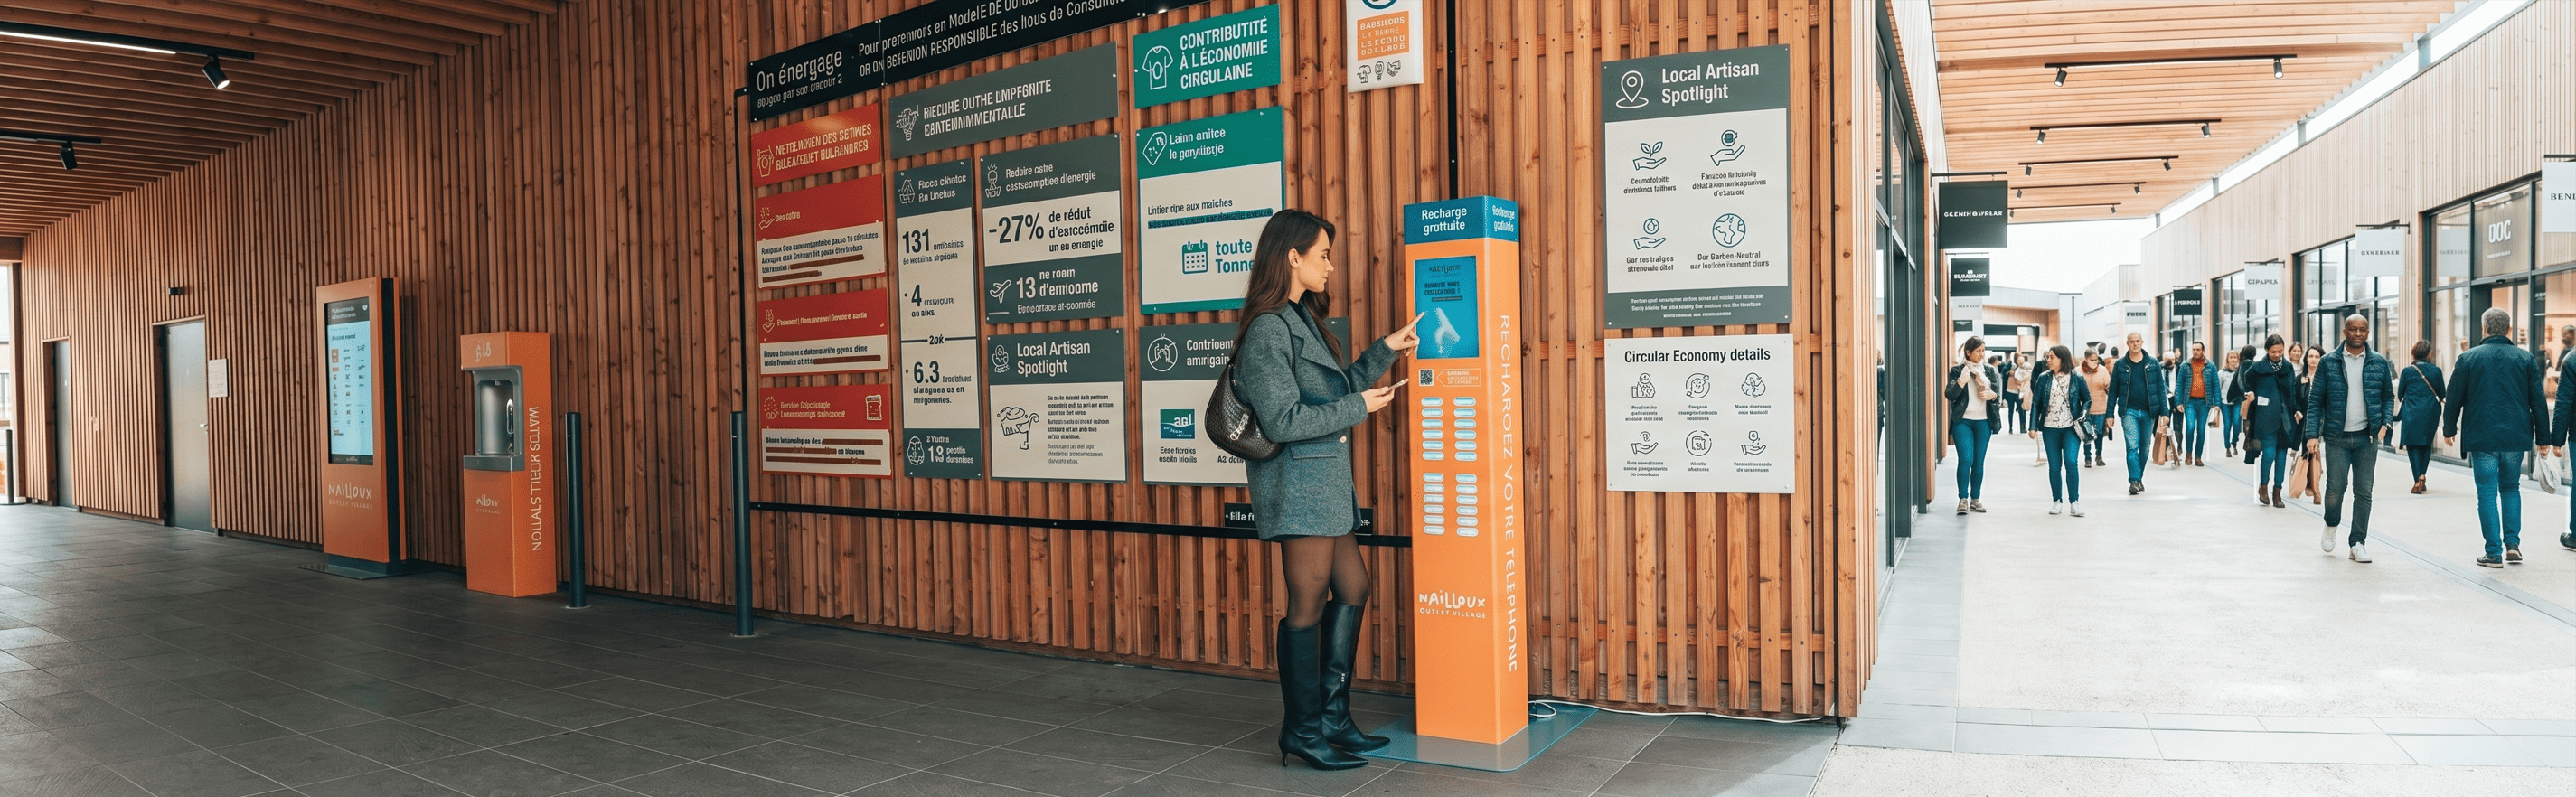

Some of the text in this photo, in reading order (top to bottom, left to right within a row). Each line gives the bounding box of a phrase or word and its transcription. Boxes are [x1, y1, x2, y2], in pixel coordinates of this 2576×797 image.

[1000, 18, 1019, 35] des
[1049, 5, 1063, 22] de
[859, 41, 879, 57] Pour
[935, 20, 946, 33] en
[757, 51, 842, 91] On énergage
[1662, 61, 1760, 83] Local Artisan
[1661, 83, 1728, 107] Spotlight
[1186, 202, 1199, 211] aux
[1421, 207, 1467, 220] Recharge
[989, 212, 1044, 244] -27%
[1048, 211, 1061, 223] de
[902, 228, 929, 253] 131
[1049, 242, 1058, 252] un
[1216, 239, 1253, 256] toute
[911, 284, 922, 306] 4
[1016, 277, 1036, 299] 13
[1017, 341, 1090, 357] Local Artisan
[1624, 348, 1771, 363] Circular Economy details
[914, 361, 940, 383] 6.3
[1017, 359, 1067, 377] Spotlight
[1504, 464, 1514, 540] VOTRE
[1419, 607, 1486, 618] OUTLET VILLAGE
